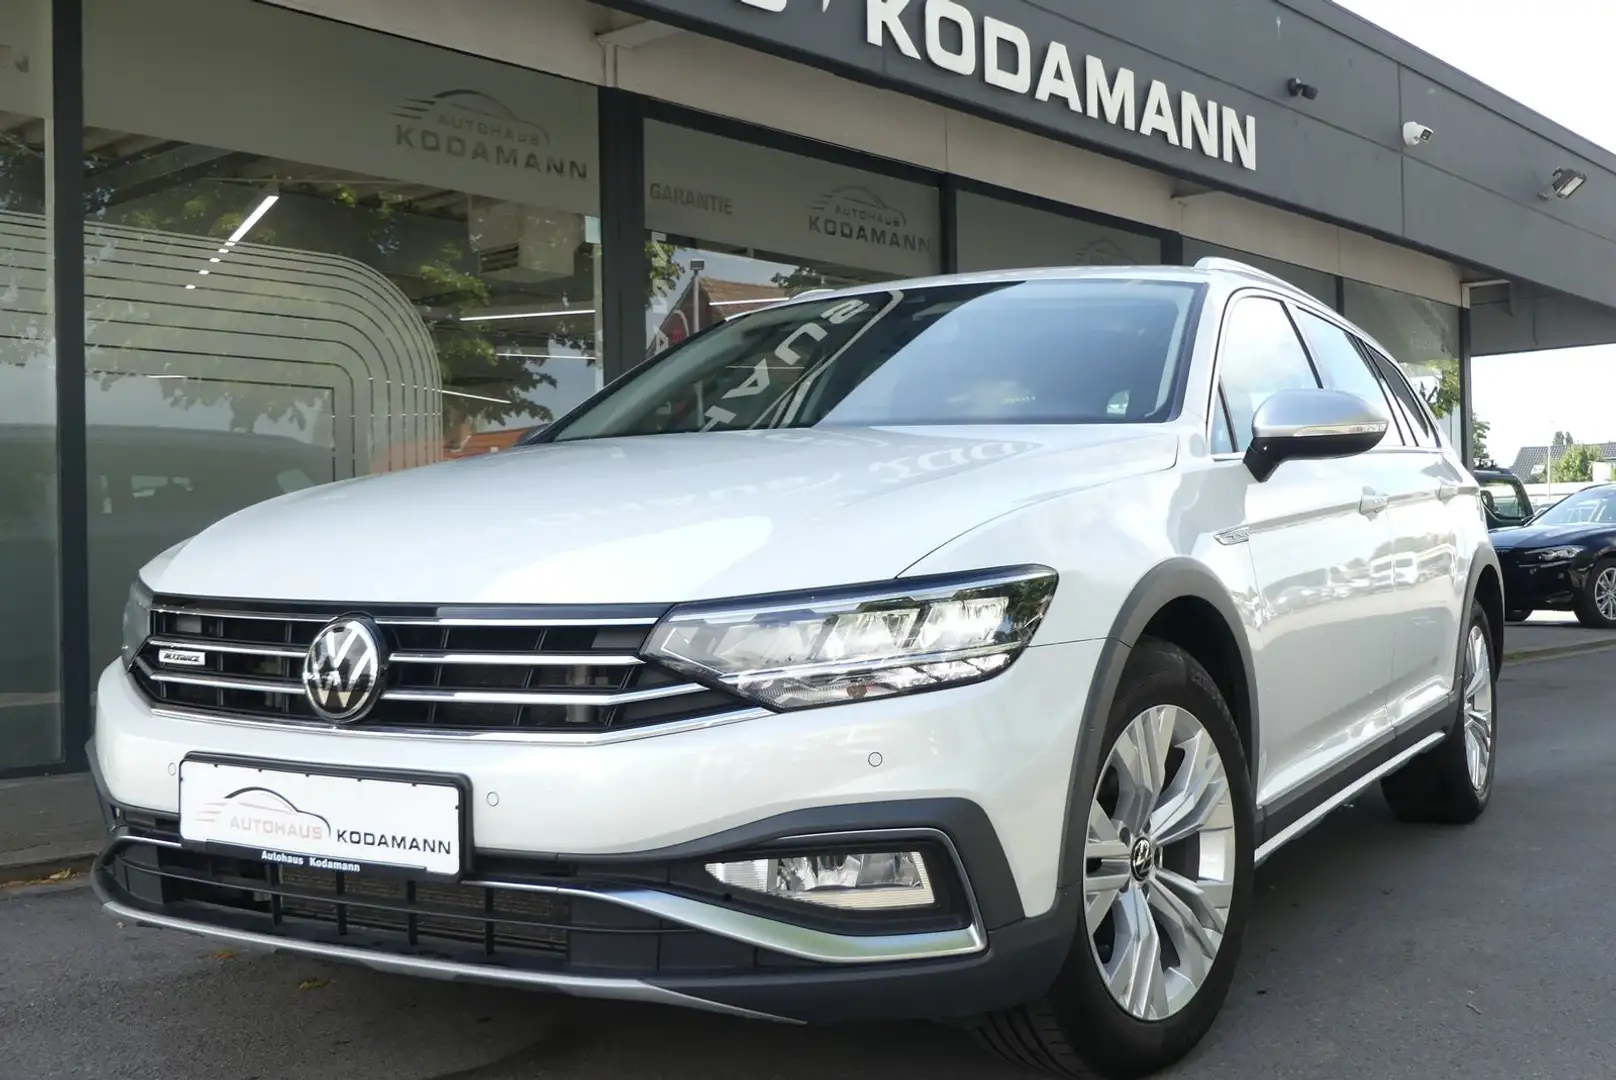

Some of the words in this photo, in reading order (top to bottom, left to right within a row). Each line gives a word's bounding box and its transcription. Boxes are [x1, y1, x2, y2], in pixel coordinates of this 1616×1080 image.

[866, 0, 1258, 171] KODAMANN
[437, 113, 540, 147] AUTOHAUS
[395, 124, 588, 180] KODAMANN
[649, 182, 734, 216] GARANTIE
[834, 203, 901, 227] AUTOHAUS
[808, 215, 933, 253] KODAMANN
[229, 814, 324, 841] AUTOHAUS
[336, 828, 452, 856] KODAMANN
[260, 850, 304, 866] Autohaus
[309, 857, 361, 873] Kodamann
